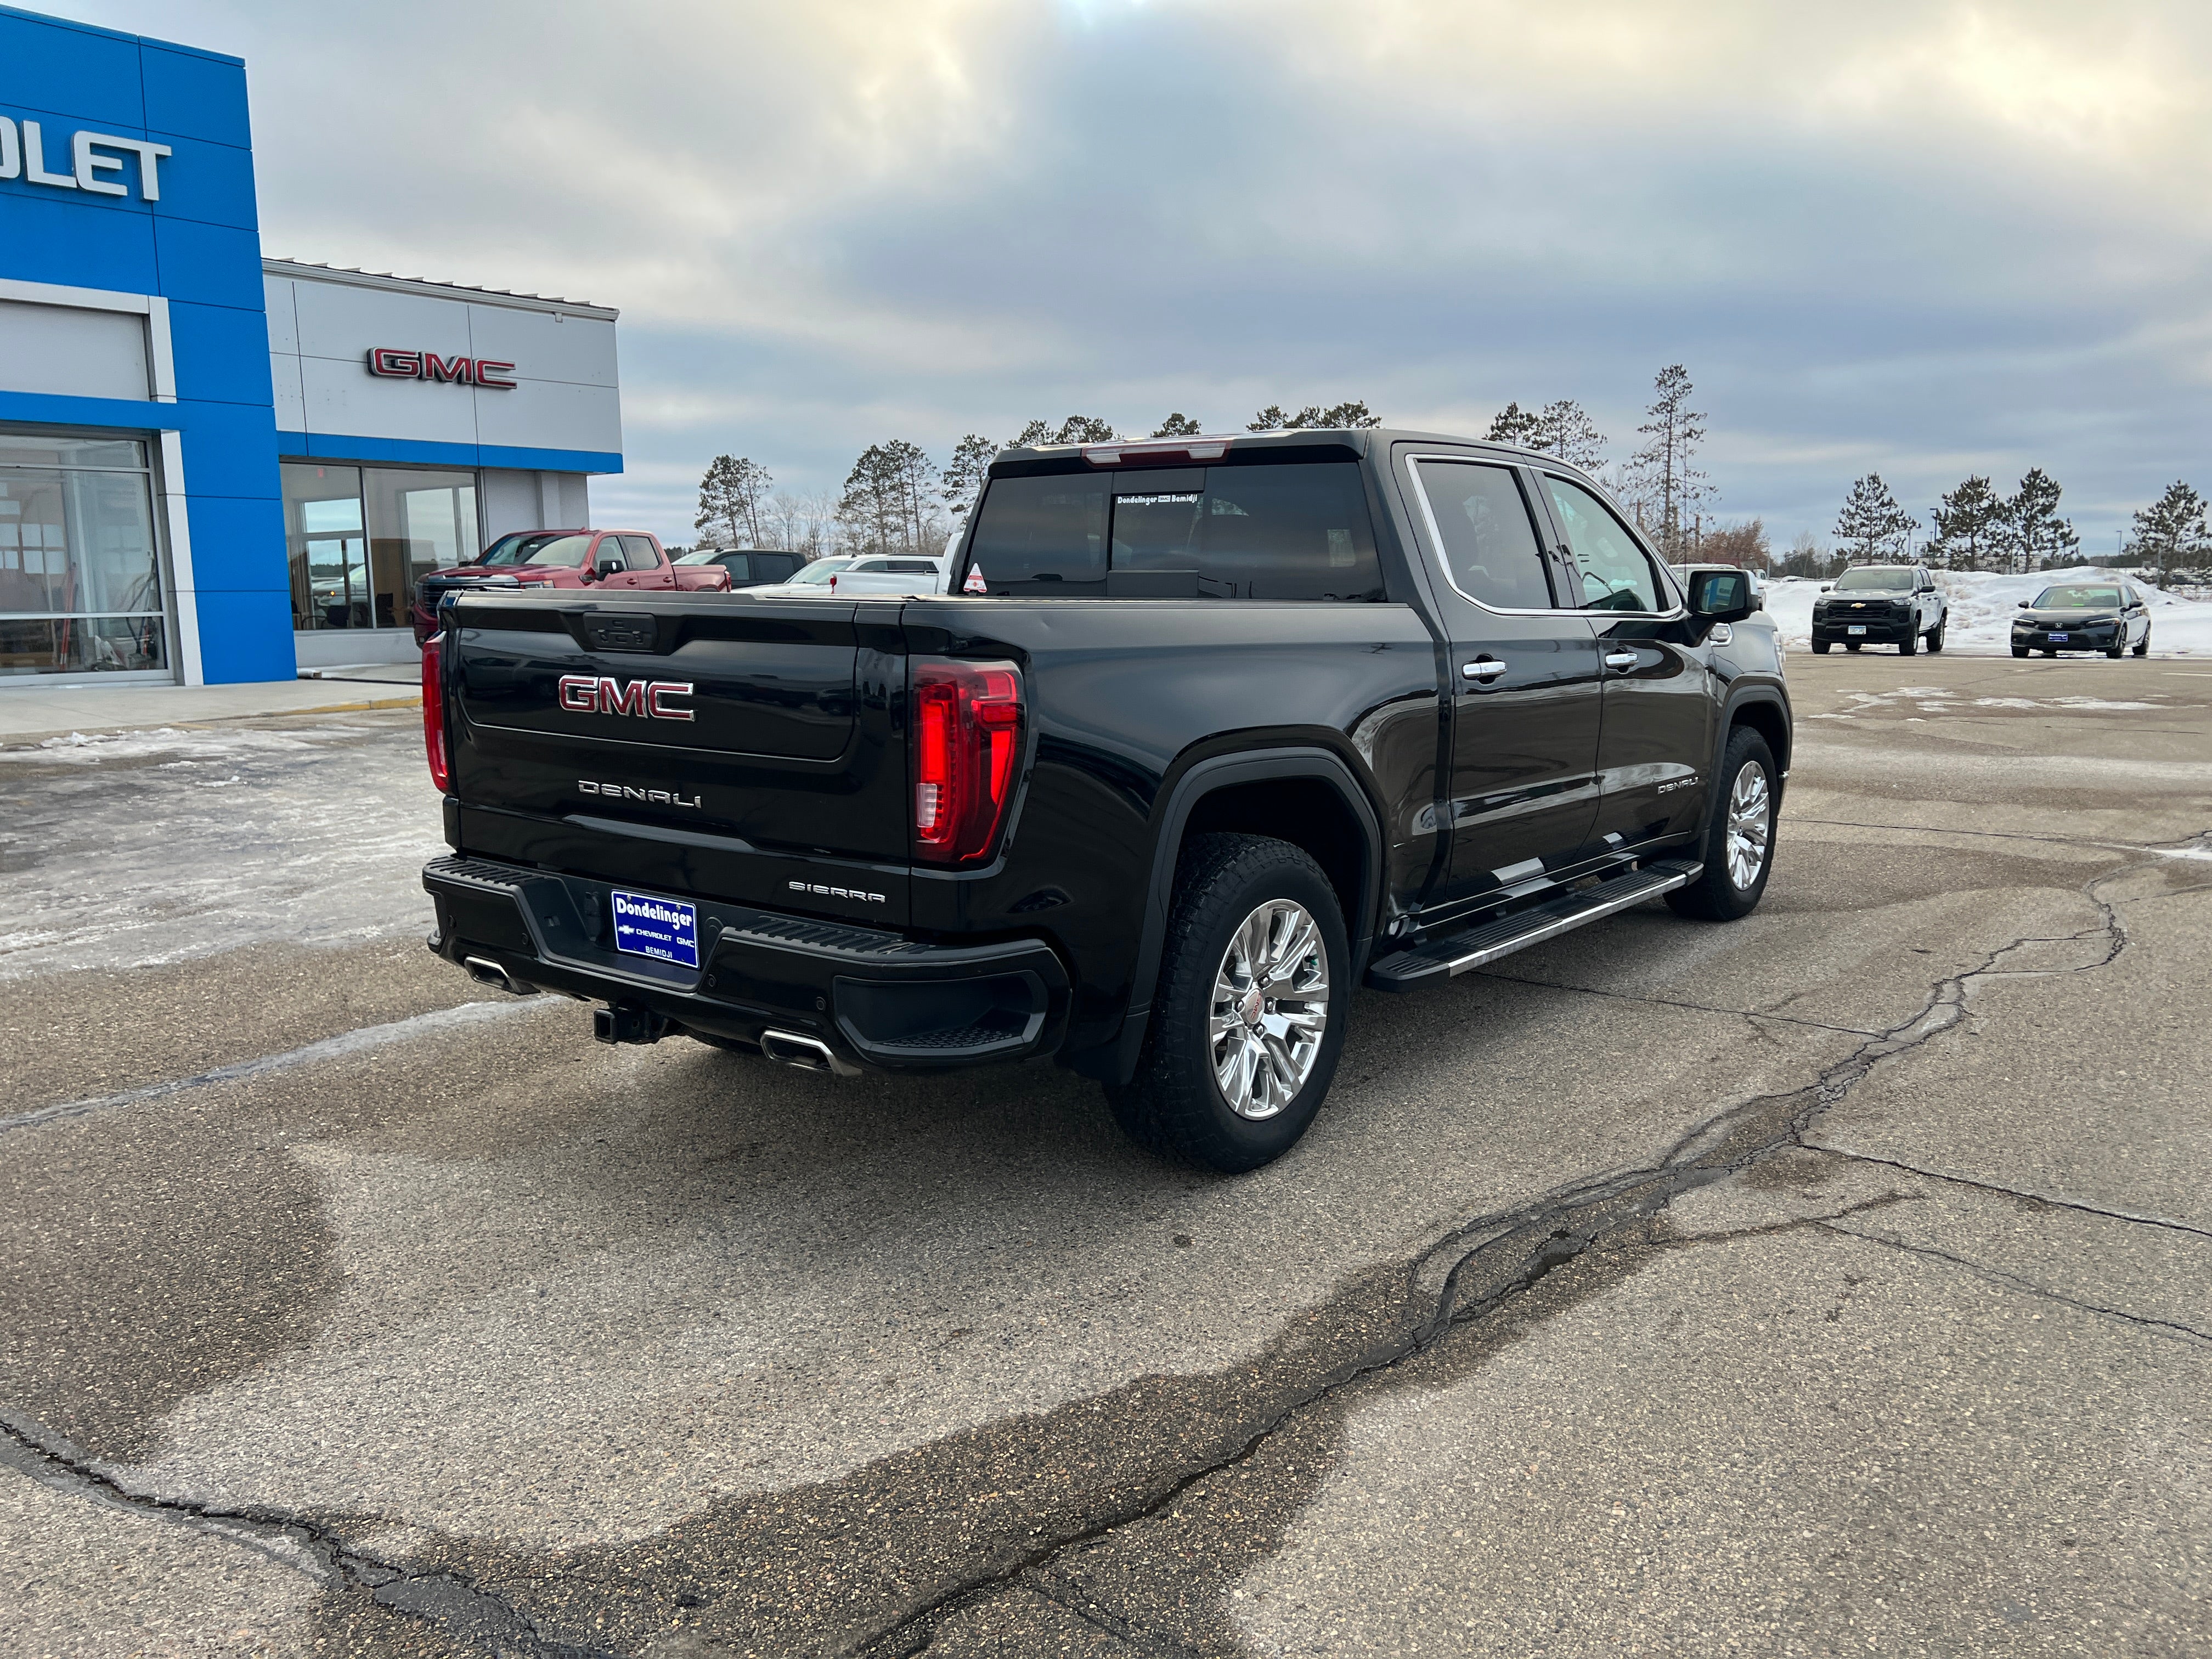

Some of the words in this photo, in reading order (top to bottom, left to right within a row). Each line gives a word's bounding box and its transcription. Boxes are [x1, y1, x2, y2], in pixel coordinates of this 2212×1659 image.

[366, 347, 517, 389] GMC
[1117, 495, 1158, 506] Dondelinger
[1171, 494, 1198, 504] Bemidji
[558, 674, 696, 722] GMC
[578, 780, 702, 809] DENALI
[1657, 776, 1699, 795] DENALI
[788, 881, 885, 904] SIERRA
[616, 897, 692, 930] Dondelinger
[636, 928, 672, 941] CHEVROLET
[676, 936, 695, 948] GMC
[645, 945, 673, 959] BEMIDJI
